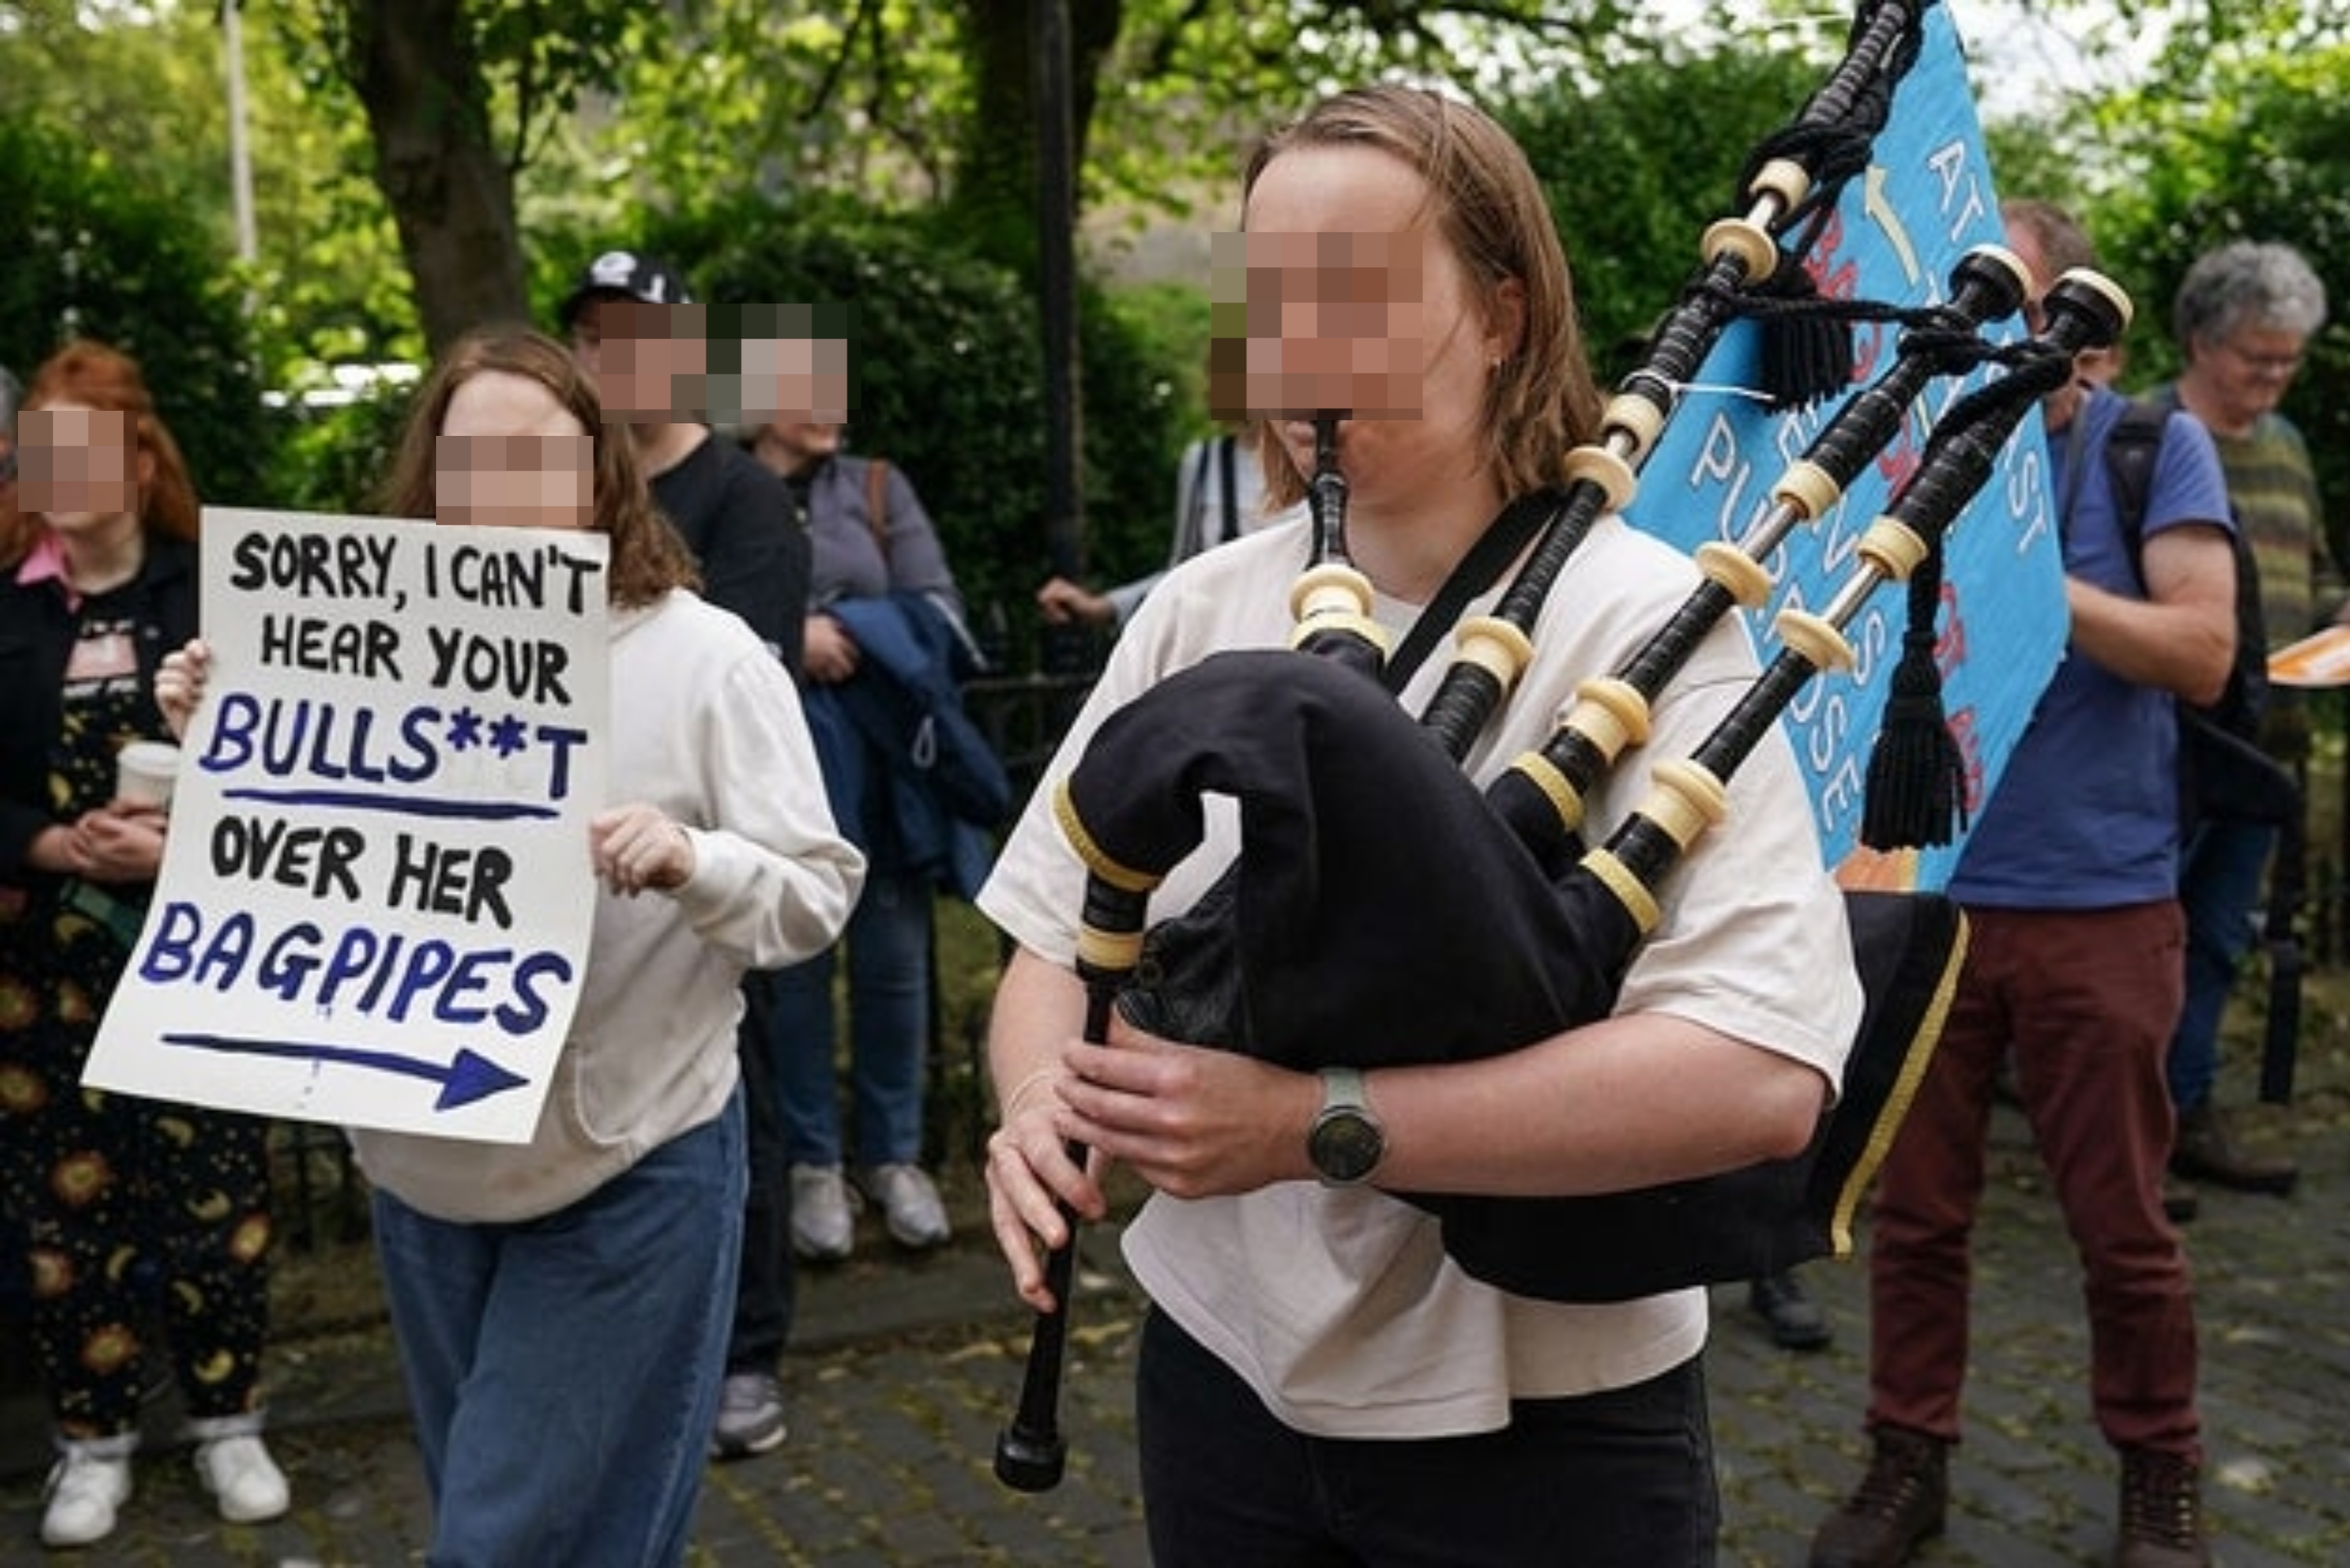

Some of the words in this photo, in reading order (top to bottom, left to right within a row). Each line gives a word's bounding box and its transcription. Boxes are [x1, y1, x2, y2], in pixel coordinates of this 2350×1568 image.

[1927, 141, 1985, 242] AT
[231, 532, 407, 611] SORRY,
[426, 543, 438, 598] I
[450, 544, 601, 615] CAN'T
[261, 615, 401, 681] HEAR
[429, 626, 571, 706] YOUR
[211, 815, 365, 902] OVER
[387, 833, 512, 929] HER
[138, 901, 573, 1036] BAGPIPES
